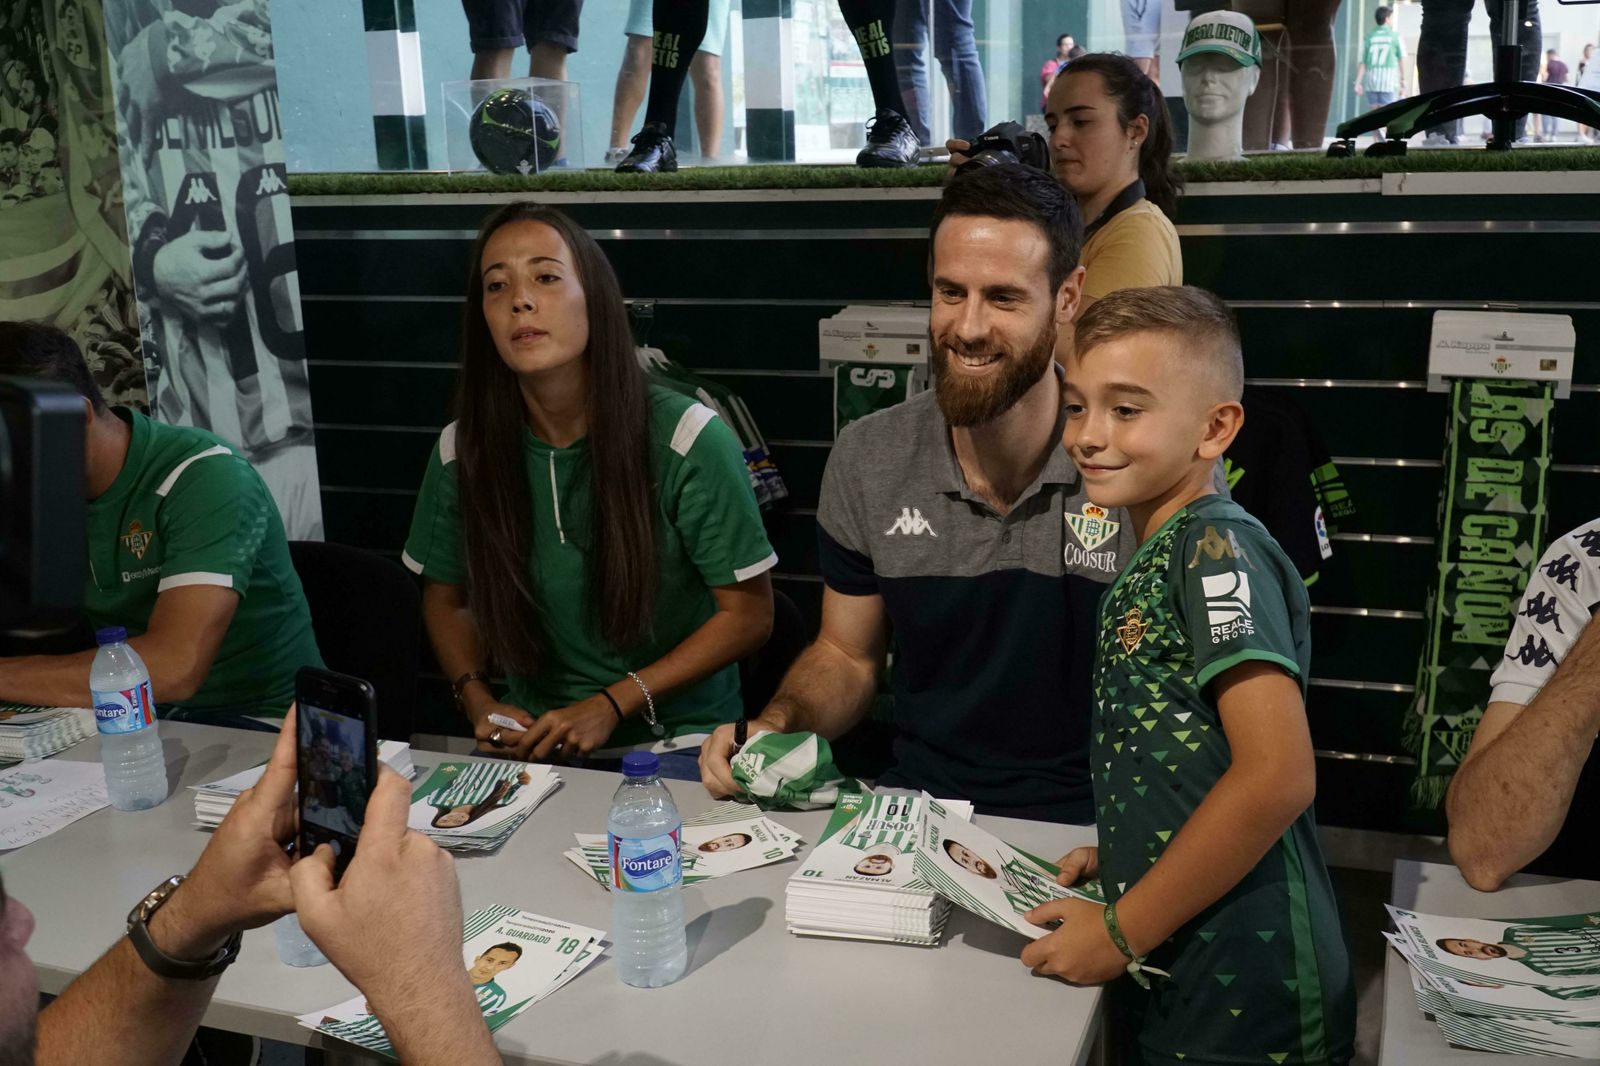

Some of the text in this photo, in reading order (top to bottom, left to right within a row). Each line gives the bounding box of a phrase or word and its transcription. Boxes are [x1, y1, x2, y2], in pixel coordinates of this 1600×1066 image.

[1186, 23, 1252, 51] REAL BETIS
[1465, 457, 1524, 500] DE
[1211, 618, 1254, 637] REALE
[1212, 628, 1254, 644] GROUP
[96, 705, 129, 718] ontarel
[928, 800, 947, 820] 10
[762, 847, 784, 860] 10
[495, 926, 552, 945] A. GUARDADO
[555, 937, 580, 954] 18
